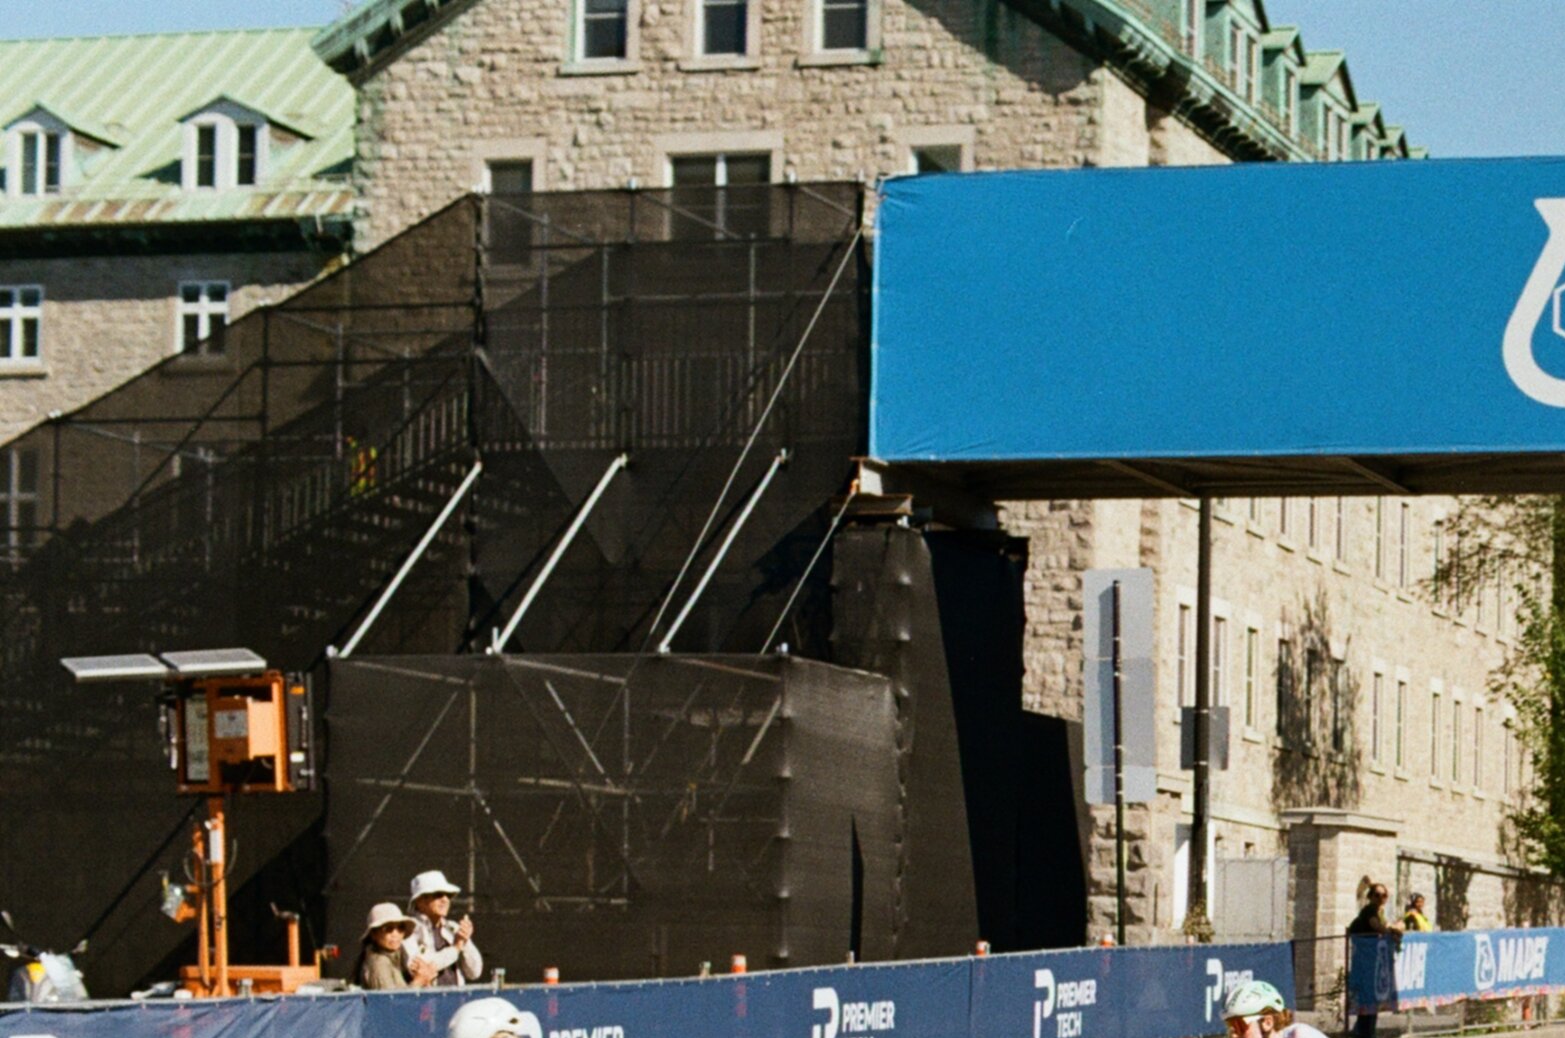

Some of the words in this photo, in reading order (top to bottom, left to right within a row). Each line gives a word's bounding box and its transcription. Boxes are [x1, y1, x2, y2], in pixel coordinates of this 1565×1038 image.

[1497, 935, 1549, 982] MAPEI
[1057, 979, 1097, 1009] PREMIER
[842, 1000, 895, 1033] PREMIER
[1056, 1011, 1082, 1038] TECH
